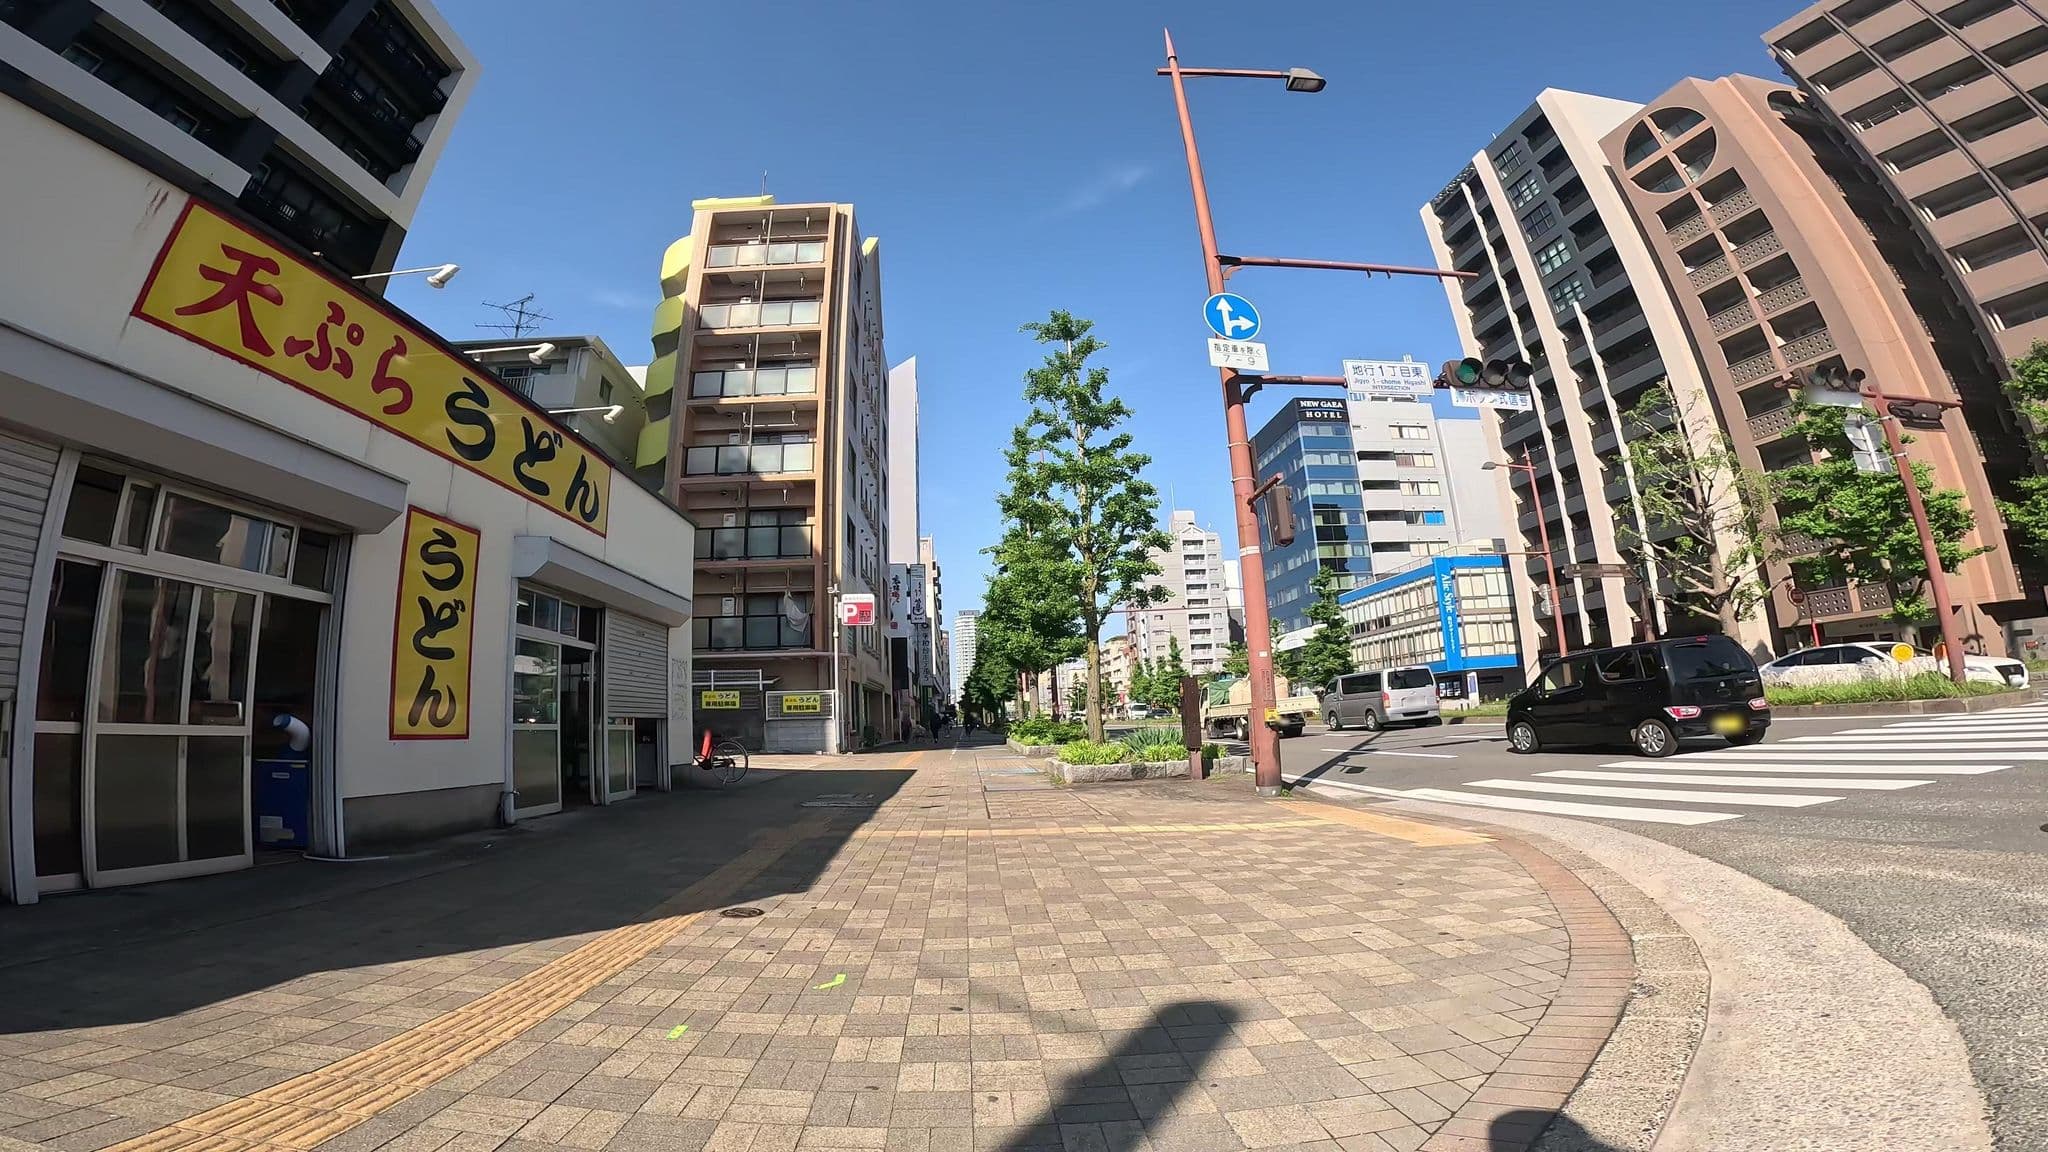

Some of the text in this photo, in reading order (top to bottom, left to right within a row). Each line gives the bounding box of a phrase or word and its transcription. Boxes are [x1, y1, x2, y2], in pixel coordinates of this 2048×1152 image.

[1213, 342, 1263, 355] 指定車を除く
[1352, 364, 1424, 378] 地行1丁目東
[174, 242, 599, 523] 天ぷら うどん
[1300, 400, 1344, 409] NEW GAEA
[1305, 411, 1343, 419] HOTEL
[843, 603, 858, 623] P
[407, 527, 466, 728] うどん
